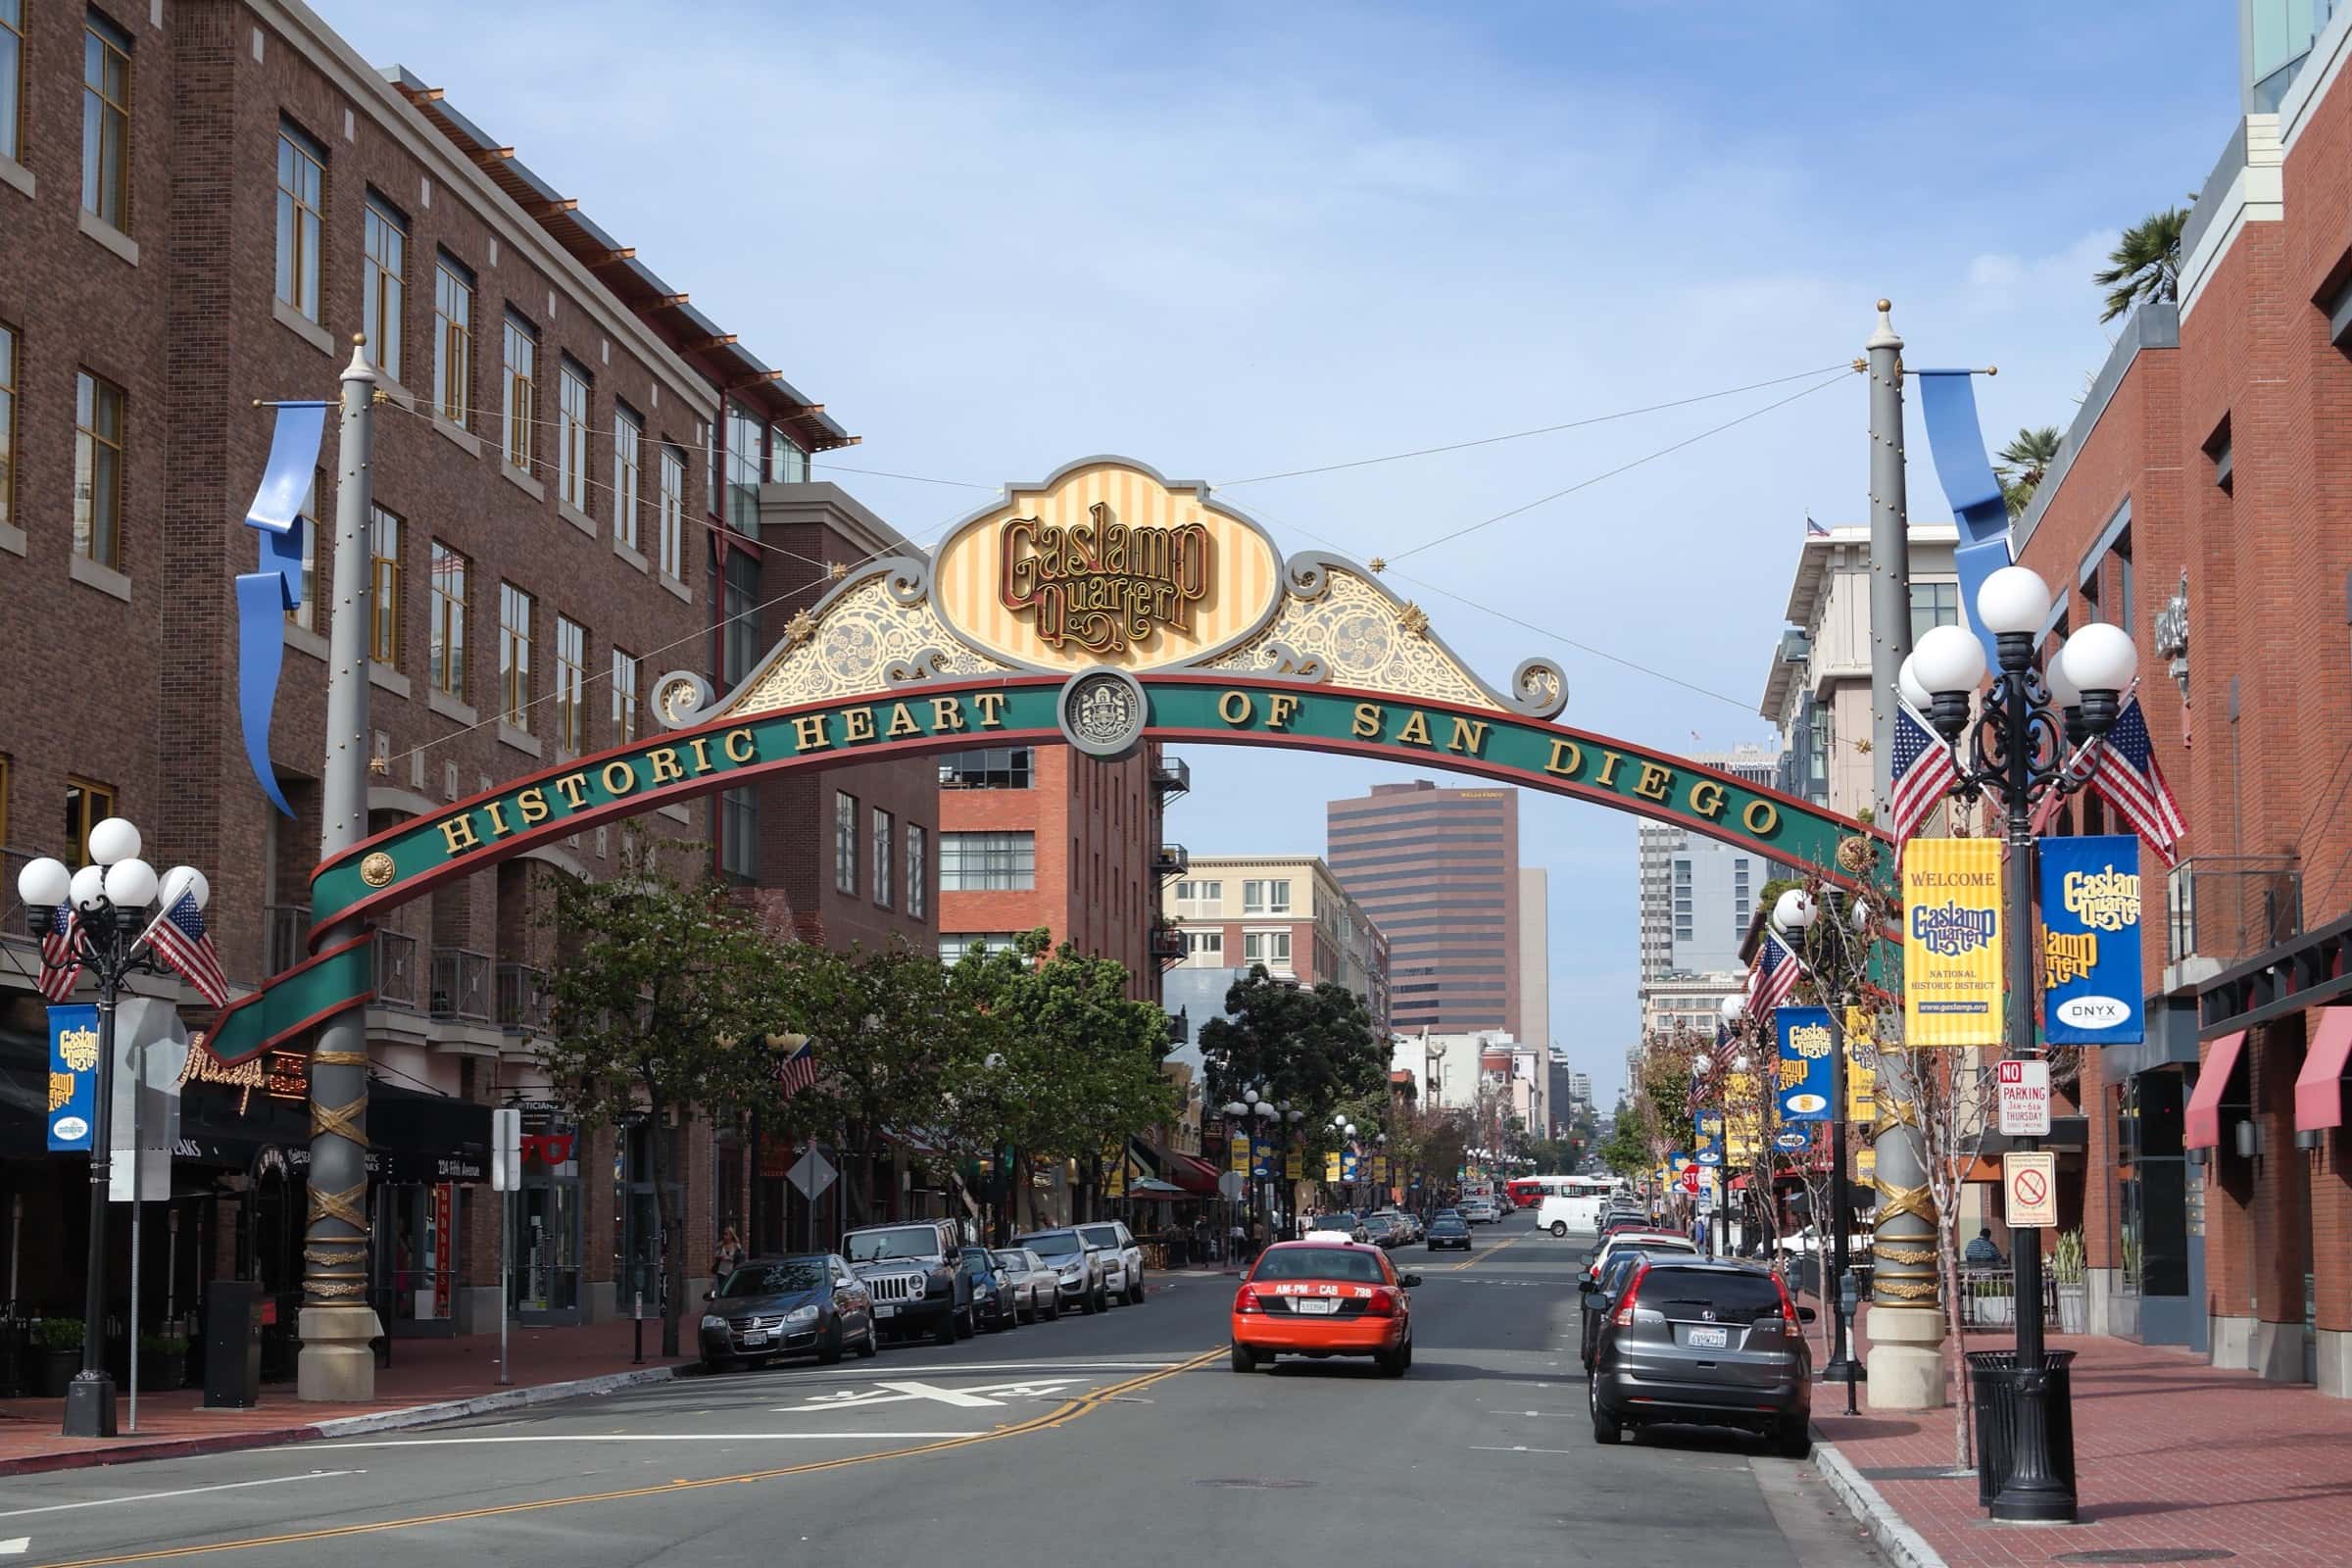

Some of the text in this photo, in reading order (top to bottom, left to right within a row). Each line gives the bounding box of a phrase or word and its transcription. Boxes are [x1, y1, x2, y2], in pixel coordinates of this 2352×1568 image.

[999, 501, 1209, 633] Gaslamp
[1033, 576, 1181, 654] Quarter
[437, 728, 754, 854] HISTORIC
[792, 694, 1004, 750] HEART
[1218, 691, 1298, 726] OF
[1351, 703, 1489, 754] SAN
[1544, 739, 1778, 833] DIEGO
[1911, 871, 1996, 887] WELCOME
[1912, 900, 1996, 950] Gaslamp
[1925, 929, 1987, 956] Quarter
[1920, 1003, 1987, 1013] www.gaslamp.org
[2072, 1005, 2116, 1016] ONYX
[2002, 1063, 2020, 1081] NO
[2003, 1087, 2046, 1101] PARKING
[2007, 1111, 2043, 1121] THURSDAY
[462, 1161, 480, 1177] Avenue
[1275, 1285, 1308, 1295] AM-PM
[1319, 1286, 1339, 1296] CAB
